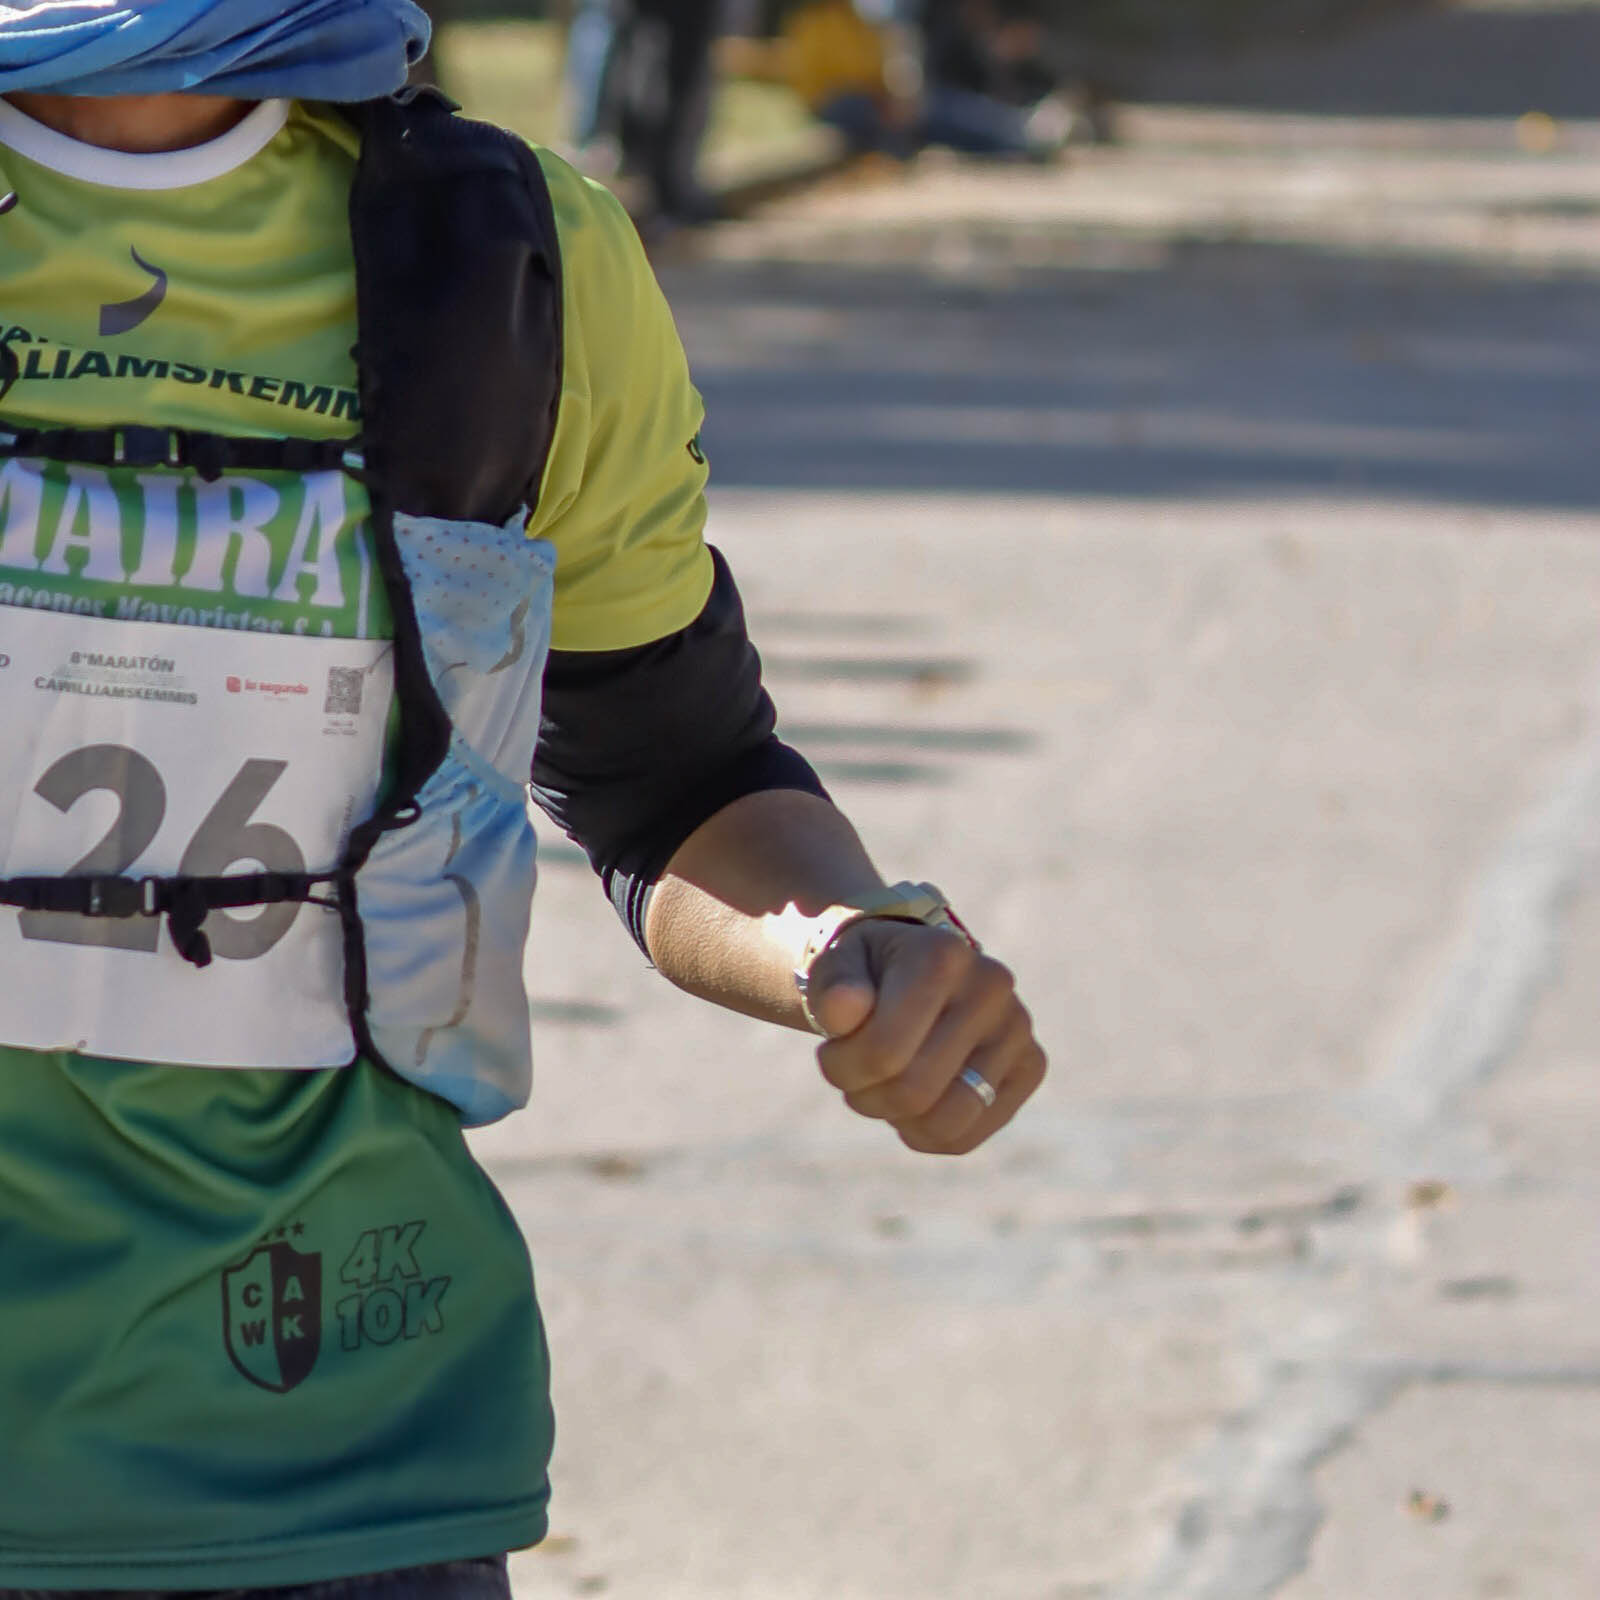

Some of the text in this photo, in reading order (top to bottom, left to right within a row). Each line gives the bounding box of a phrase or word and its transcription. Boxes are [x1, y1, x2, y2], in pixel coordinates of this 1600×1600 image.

[339, 1219, 427, 1289] 4K
[242, 1275, 304, 1308] C A
[335, 1276, 452, 1352] 10K
[240, 1313, 304, 1347] W K
